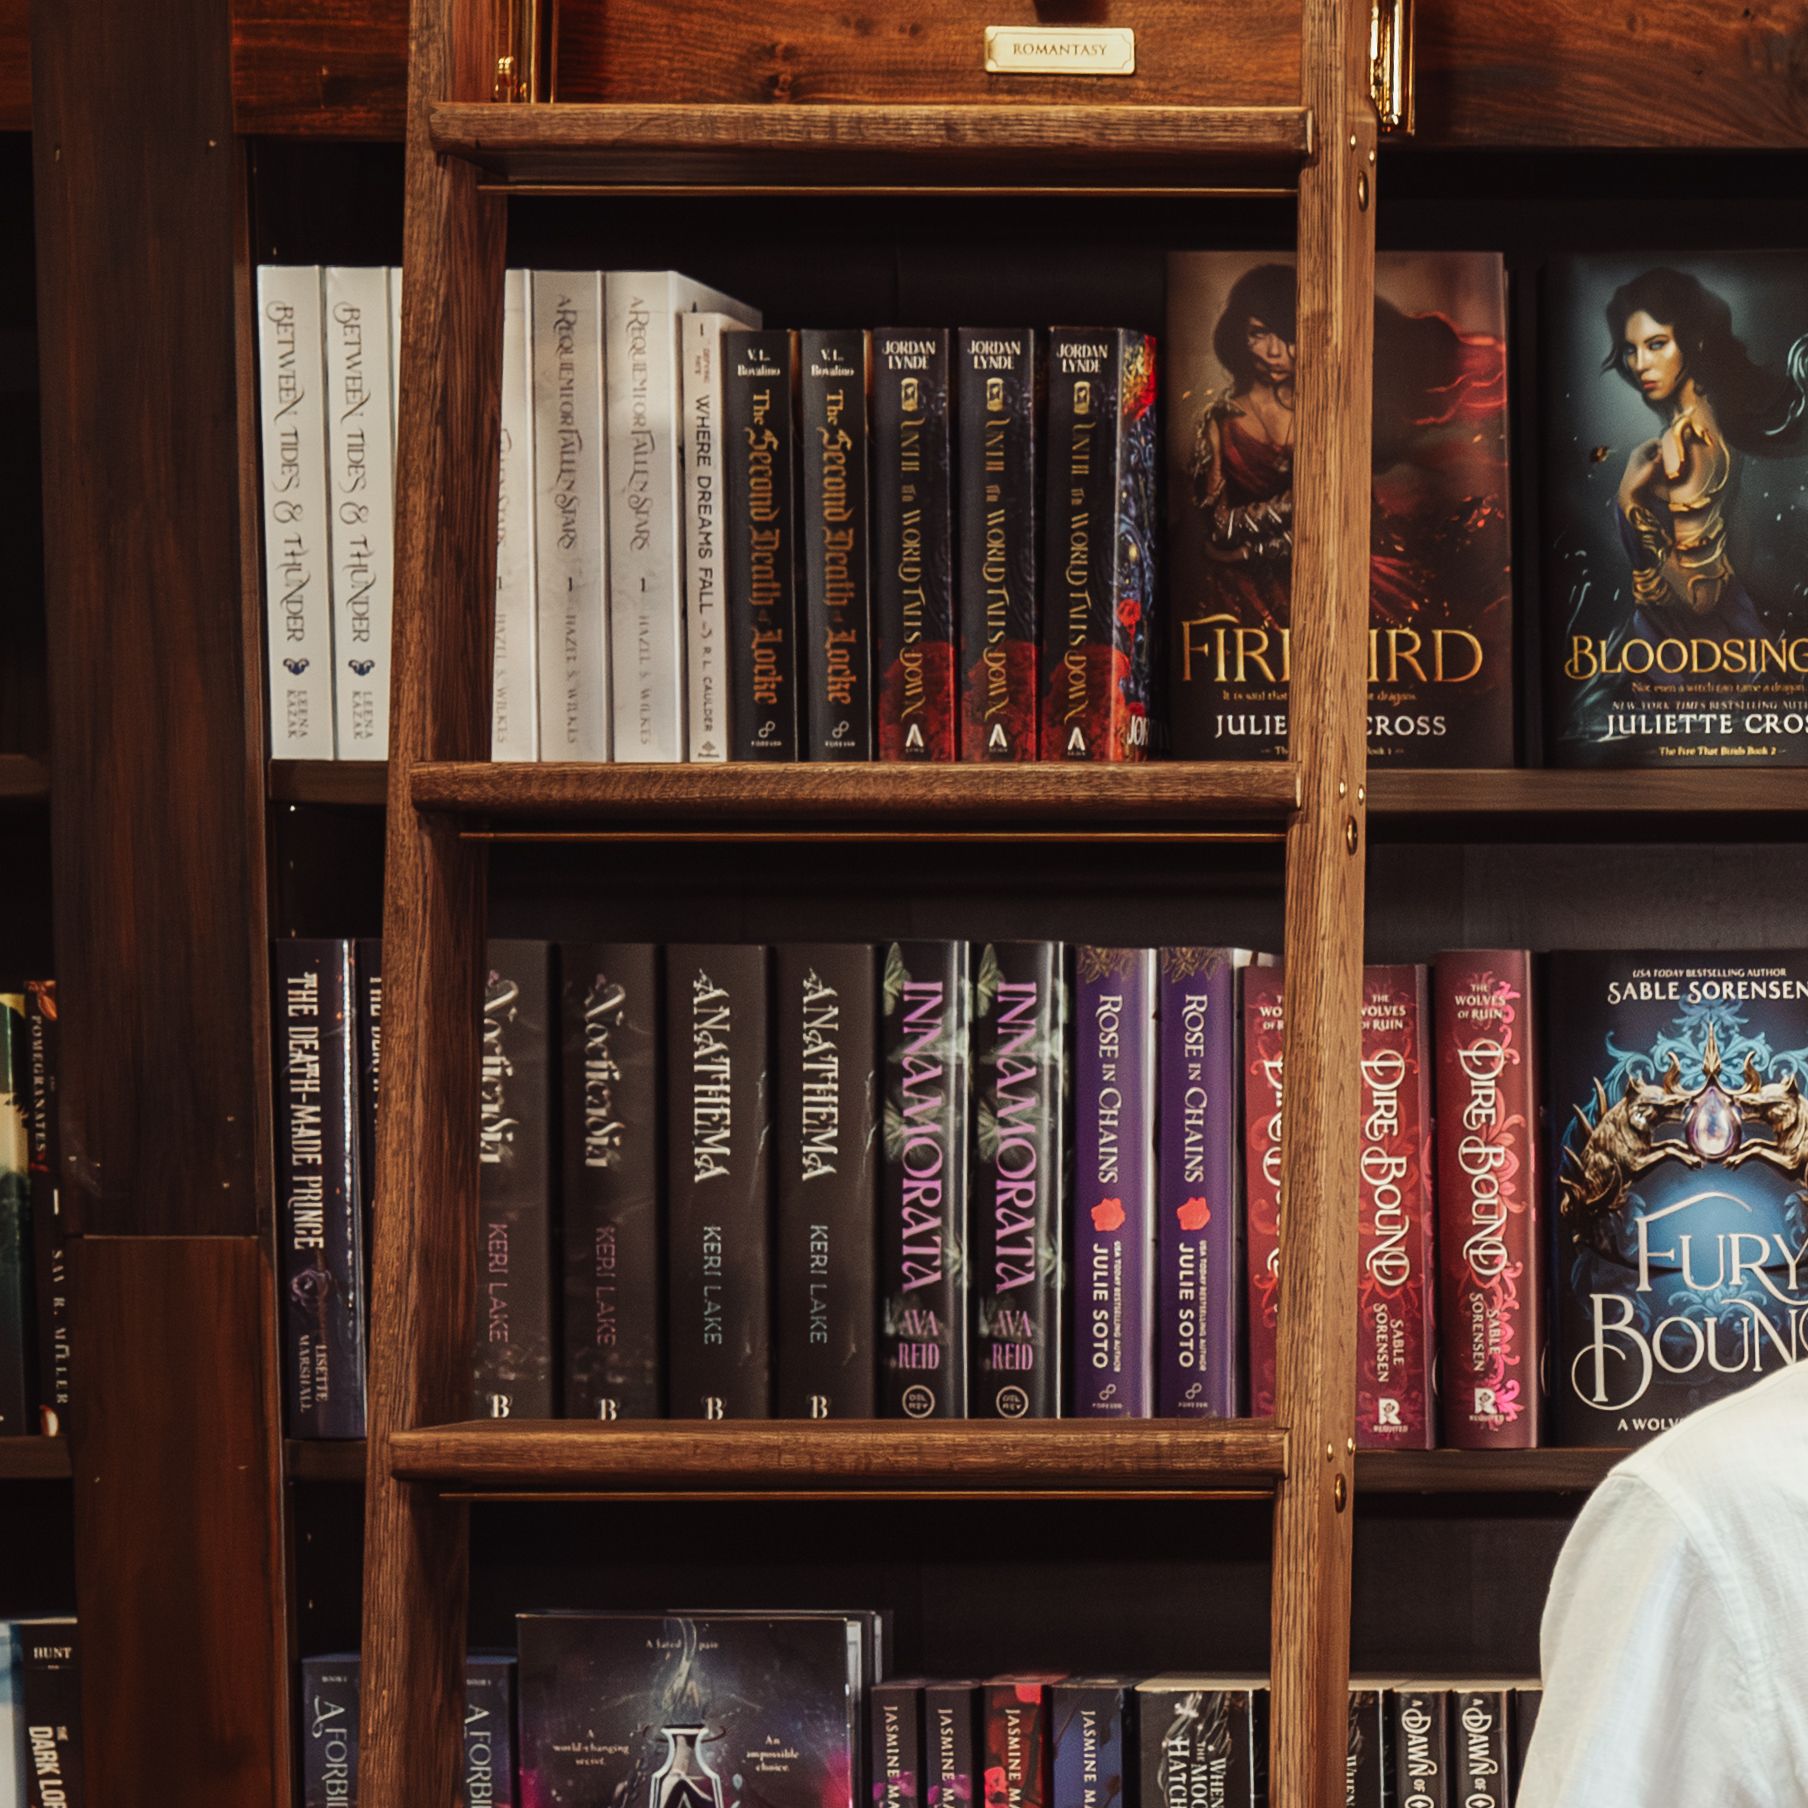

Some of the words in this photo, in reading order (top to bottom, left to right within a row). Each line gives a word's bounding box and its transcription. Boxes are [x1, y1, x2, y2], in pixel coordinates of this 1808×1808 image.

[1012, 42, 1108, 57] ROMANTASY
[265, 301, 305, 421] BETWEEN
[882, 340, 936, 355] JORDAN
[888, 355, 929, 370] LYNDE
[694, 395, 713, 468] WHERE
[272, 430, 299, 493] TIDES
[273, 499, 303, 525] &
[697, 475, 713, 559] DREAMS
[277, 531, 312, 643] THUNDER
[699, 568, 713, 616] FALL
[1605, 713, 1733, 738] JULIETTE
[287, 972, 319, 1018] THE
[1607, 980, 1680, 1004] SABLE
[1632, 969, 1649, 978] USA
[1652, 969, 1684, 978] TODAY
[1686, 968, 1745, 978] BESTSELLING
[1746, 968, 1787, 977] AUTHOR
[1096, 994, 1123, 1058] ROSE
[287, 1026, 322, 1166] DEATH-MADE
[693, 969, 731, 1182] ANATHEMA
[1102, 1063, 1116, 1082] IN
[1457, 1039, 1505, 1131] DIRE
[902, 980, 943, 1292] INNAMORATA
[1098, 1087, 1122, 1184] CHAINS
[288, 1175, 324, 1250] PRINCE
[1458, 1140, 1508, 1277] BOUND
[703, 1226, 722, 1278] KERI
[1092, 1244, 1109, 1301] JULIE
[703, 1286, 723, 1345] LAKE
[904, 1309, 939, 1338] AVA
[1092, 1309, 1109, 1368] SOTO
[898, 1343, 940, 1370] REID
[29, 1725, 60, 1775] DARK
[1005, 1708, 1020, 1781] JASMINE
